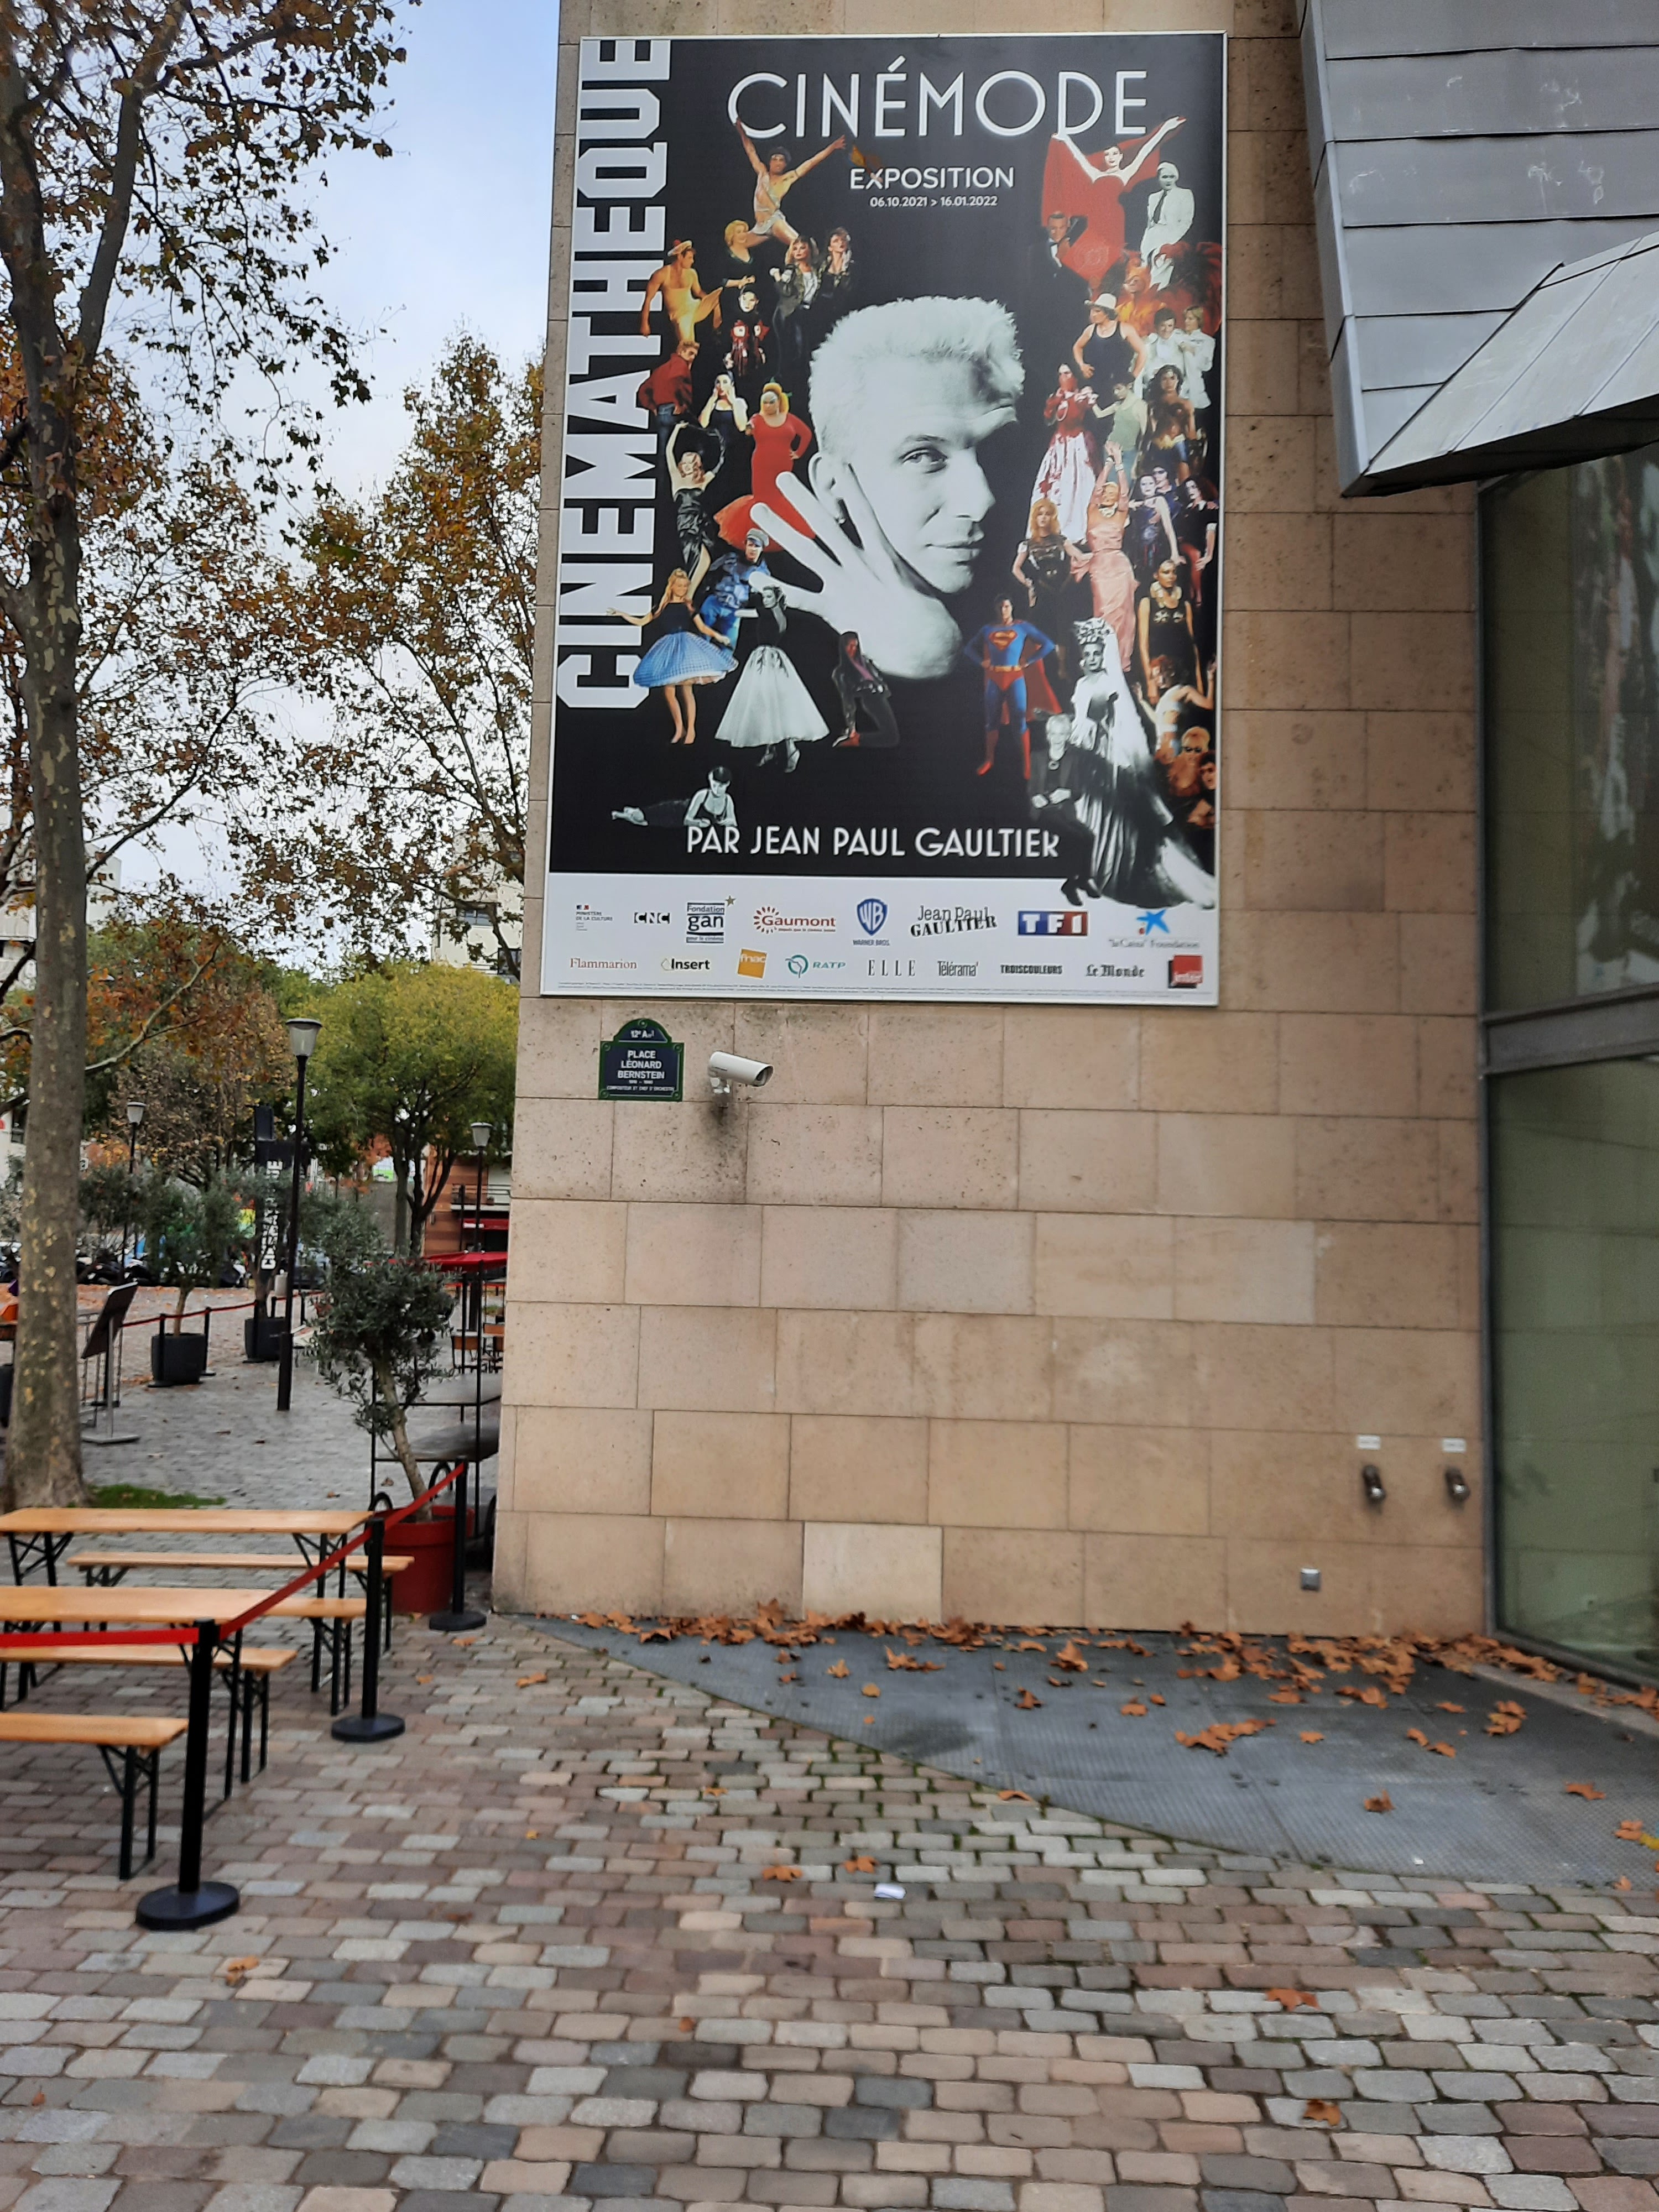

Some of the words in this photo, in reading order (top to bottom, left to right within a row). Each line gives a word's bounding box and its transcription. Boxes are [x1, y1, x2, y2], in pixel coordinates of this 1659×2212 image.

[727, 55, 1147, 138] CINÉMODE
[850, 166, 1014, 190] EXPOSITION
[870, 196, 928, 207] 06.10.2021
[941, 195, 998, 207] 16.01.2022
[687, 826, 740, 854] PAR
[750, 826, 820, 855] JEAN
[833, 827, 905, 857] PAUL
[915, 828, 1060, 858] GAULTIER
[634, 912, 670, 924] CNC
[917, 905, 952, 921] Jean
[955, 905, 988, 921] Paul
[688, 915, 724, 931] gan
[761, 915, 836, 927] Gaumont
[910, 915, 998, 937] GAULTIER
[1022, 913, 1082, 935] TF1
[570, 958, 638, 970] Flammarion
[671, 958, 711, 970] Insert
[1086, 964, 1099, 977] Le
[1099, 964, 1145, 978] Monde
[627, 1050, 656, 1059] PLACE
[617, 1070, 665, 1079] BERNSTEIN
